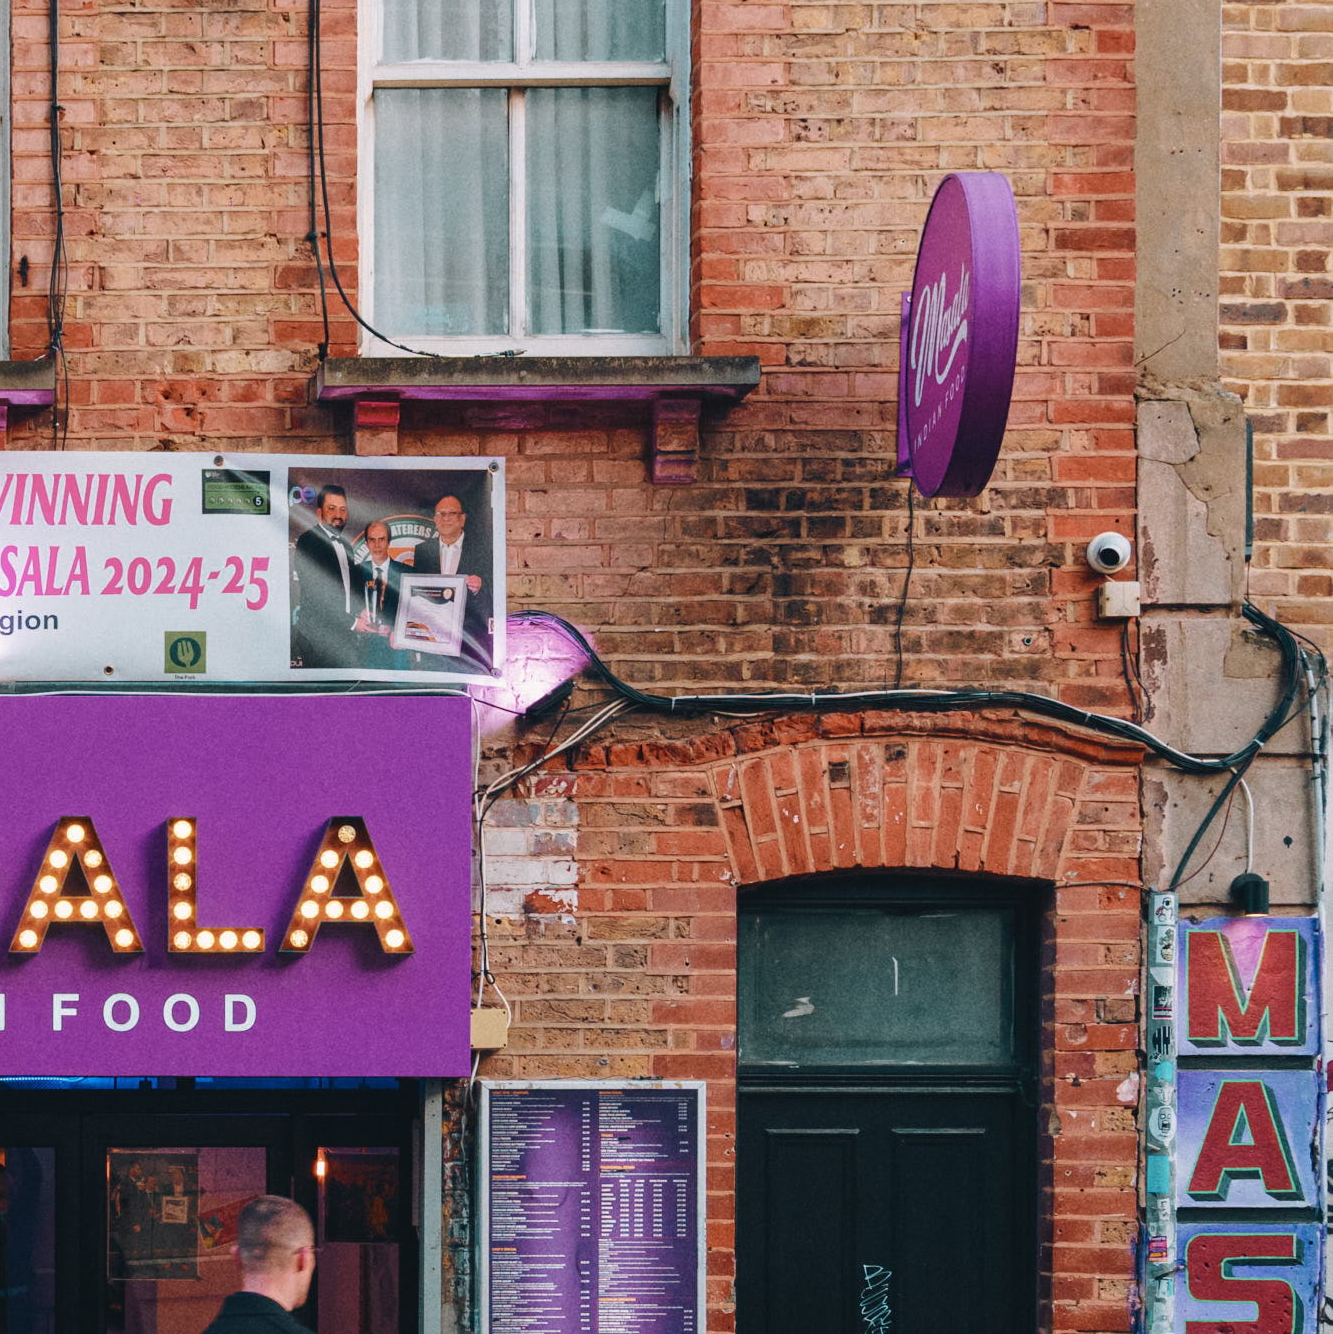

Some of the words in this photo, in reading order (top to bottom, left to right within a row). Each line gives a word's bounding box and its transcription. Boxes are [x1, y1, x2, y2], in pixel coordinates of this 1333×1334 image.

[914, 404, 942, 453] INDIAN
[944, 365, 966, 409] FOOD
[390, 524, 431, 539] ATERERS
[100, 555, 270, 610] 2024-25
[52, 992, 260, 1032] FOOD
